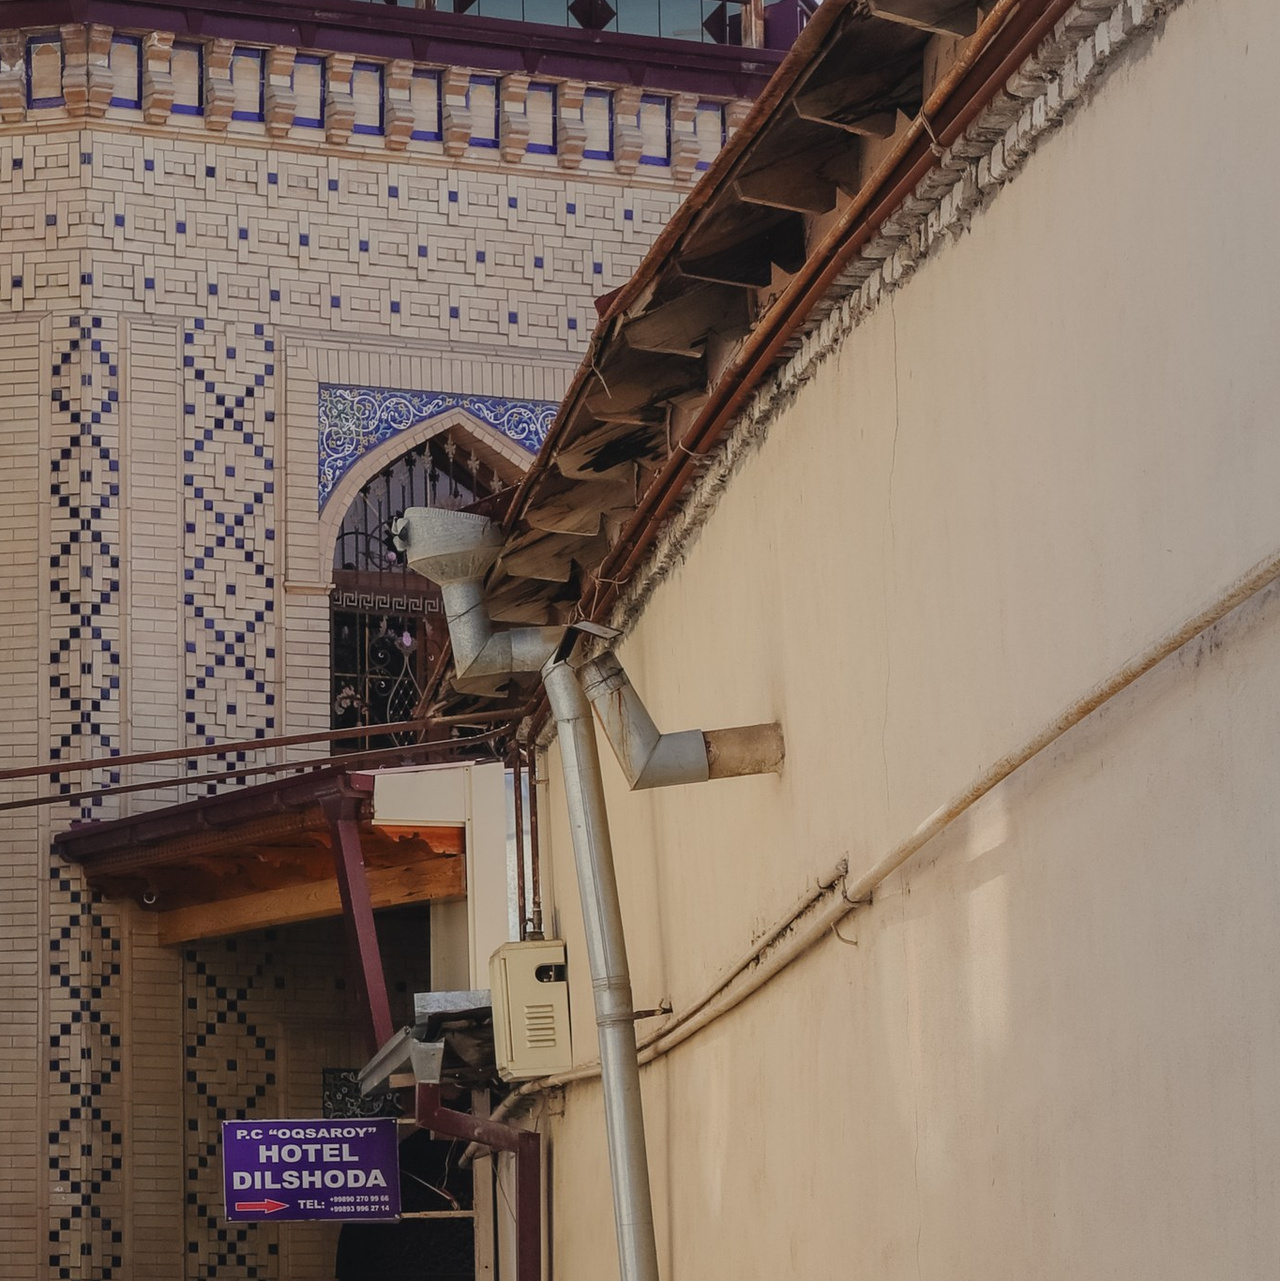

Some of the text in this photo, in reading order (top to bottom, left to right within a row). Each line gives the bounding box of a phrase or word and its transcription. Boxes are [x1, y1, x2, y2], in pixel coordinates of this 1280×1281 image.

[236, 1129, 263, 1140] P.C
[259, 1143, 359, 1164] HOTEL
[232, 1169, 387, 1191] DILSHODA
[297, 1199, 325, 1209] TEL:
